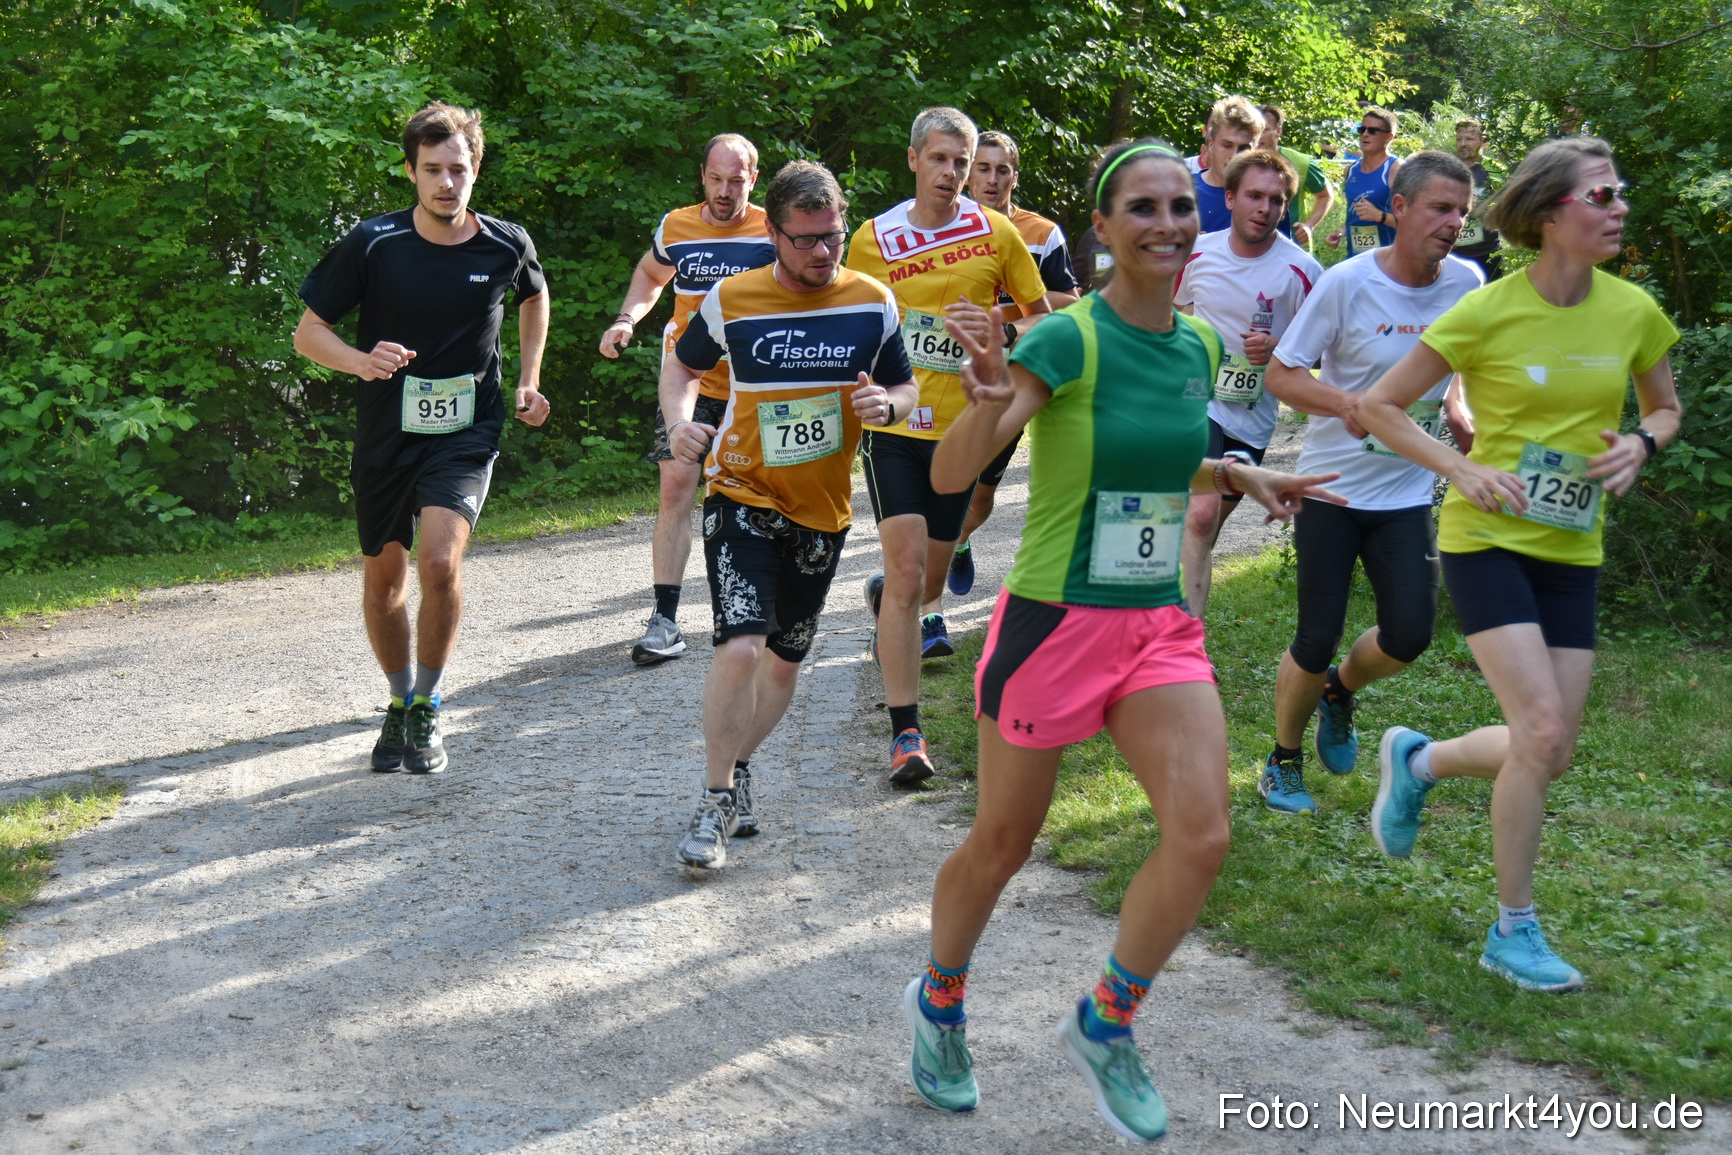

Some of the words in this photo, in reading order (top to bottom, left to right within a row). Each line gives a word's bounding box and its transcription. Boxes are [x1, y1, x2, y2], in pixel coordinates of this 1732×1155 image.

[1353, 235, 1375, 246] 1523
[687, 262, 749, 276] Fischer
[888, 257, 937, 284] MAX
[942, 242, 997, 266] BÖGL
[770, 342, 856, 360] Fischer
[911, 332, 964, 358] 1646
[779, 360, 849, 369] AUTOMOBILE
[913, 352, 928, 360] Pflug
[929, 356, 956, 364] Christoph
[1222, 370, 1258, 389] 786
[418, 397, 457, 419] 951
[776, 420, 825, 448] 788
[774, 447, 806, 455] Wittmann
[807, 440, 832, 450] Andreas
[1526, 473, 1592, 511] 1250
[1138, 527, 1154, 559] 8
